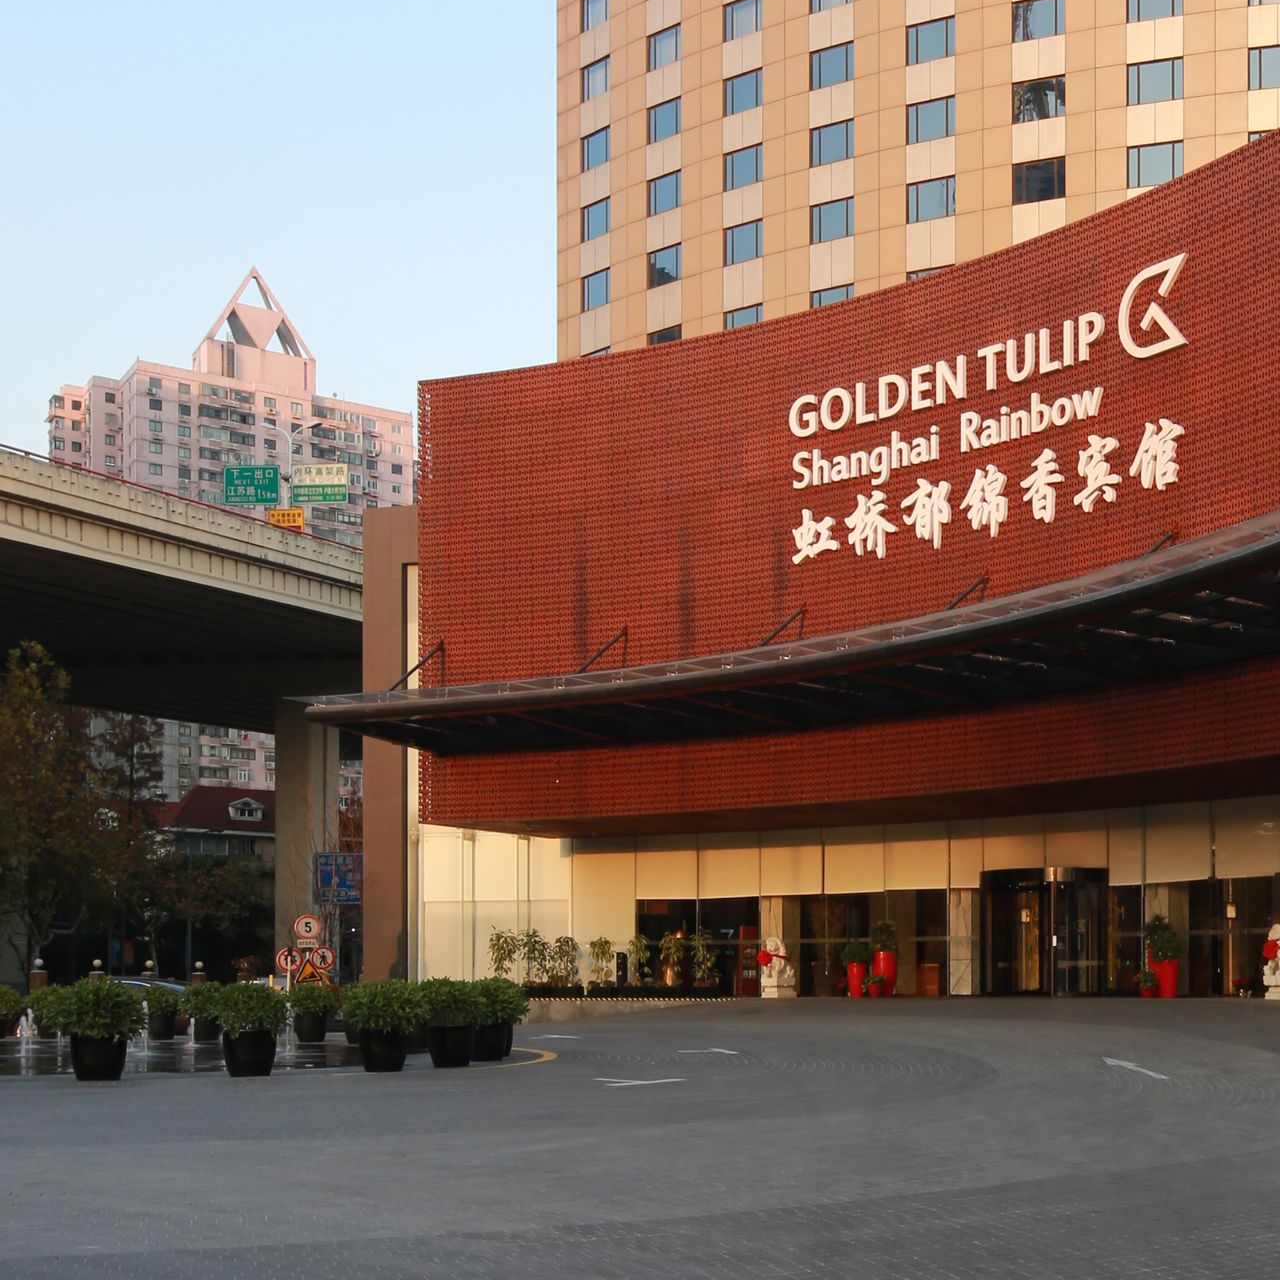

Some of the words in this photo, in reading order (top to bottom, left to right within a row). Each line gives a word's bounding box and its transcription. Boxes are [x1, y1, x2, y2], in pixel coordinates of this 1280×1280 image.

[788, 354, 967, 439] GOLDEN
[977, 311, 1106, 392] TULIP
[230, 469, 274, 479] 下一出口
[791, 424, 940, 489] Shanghai
[959, 385, 1104, 453] Rainbow
[791, 416, 1186, 565] 虹桥郁锦香宾馆
[304, 921, 312, 933] 5
